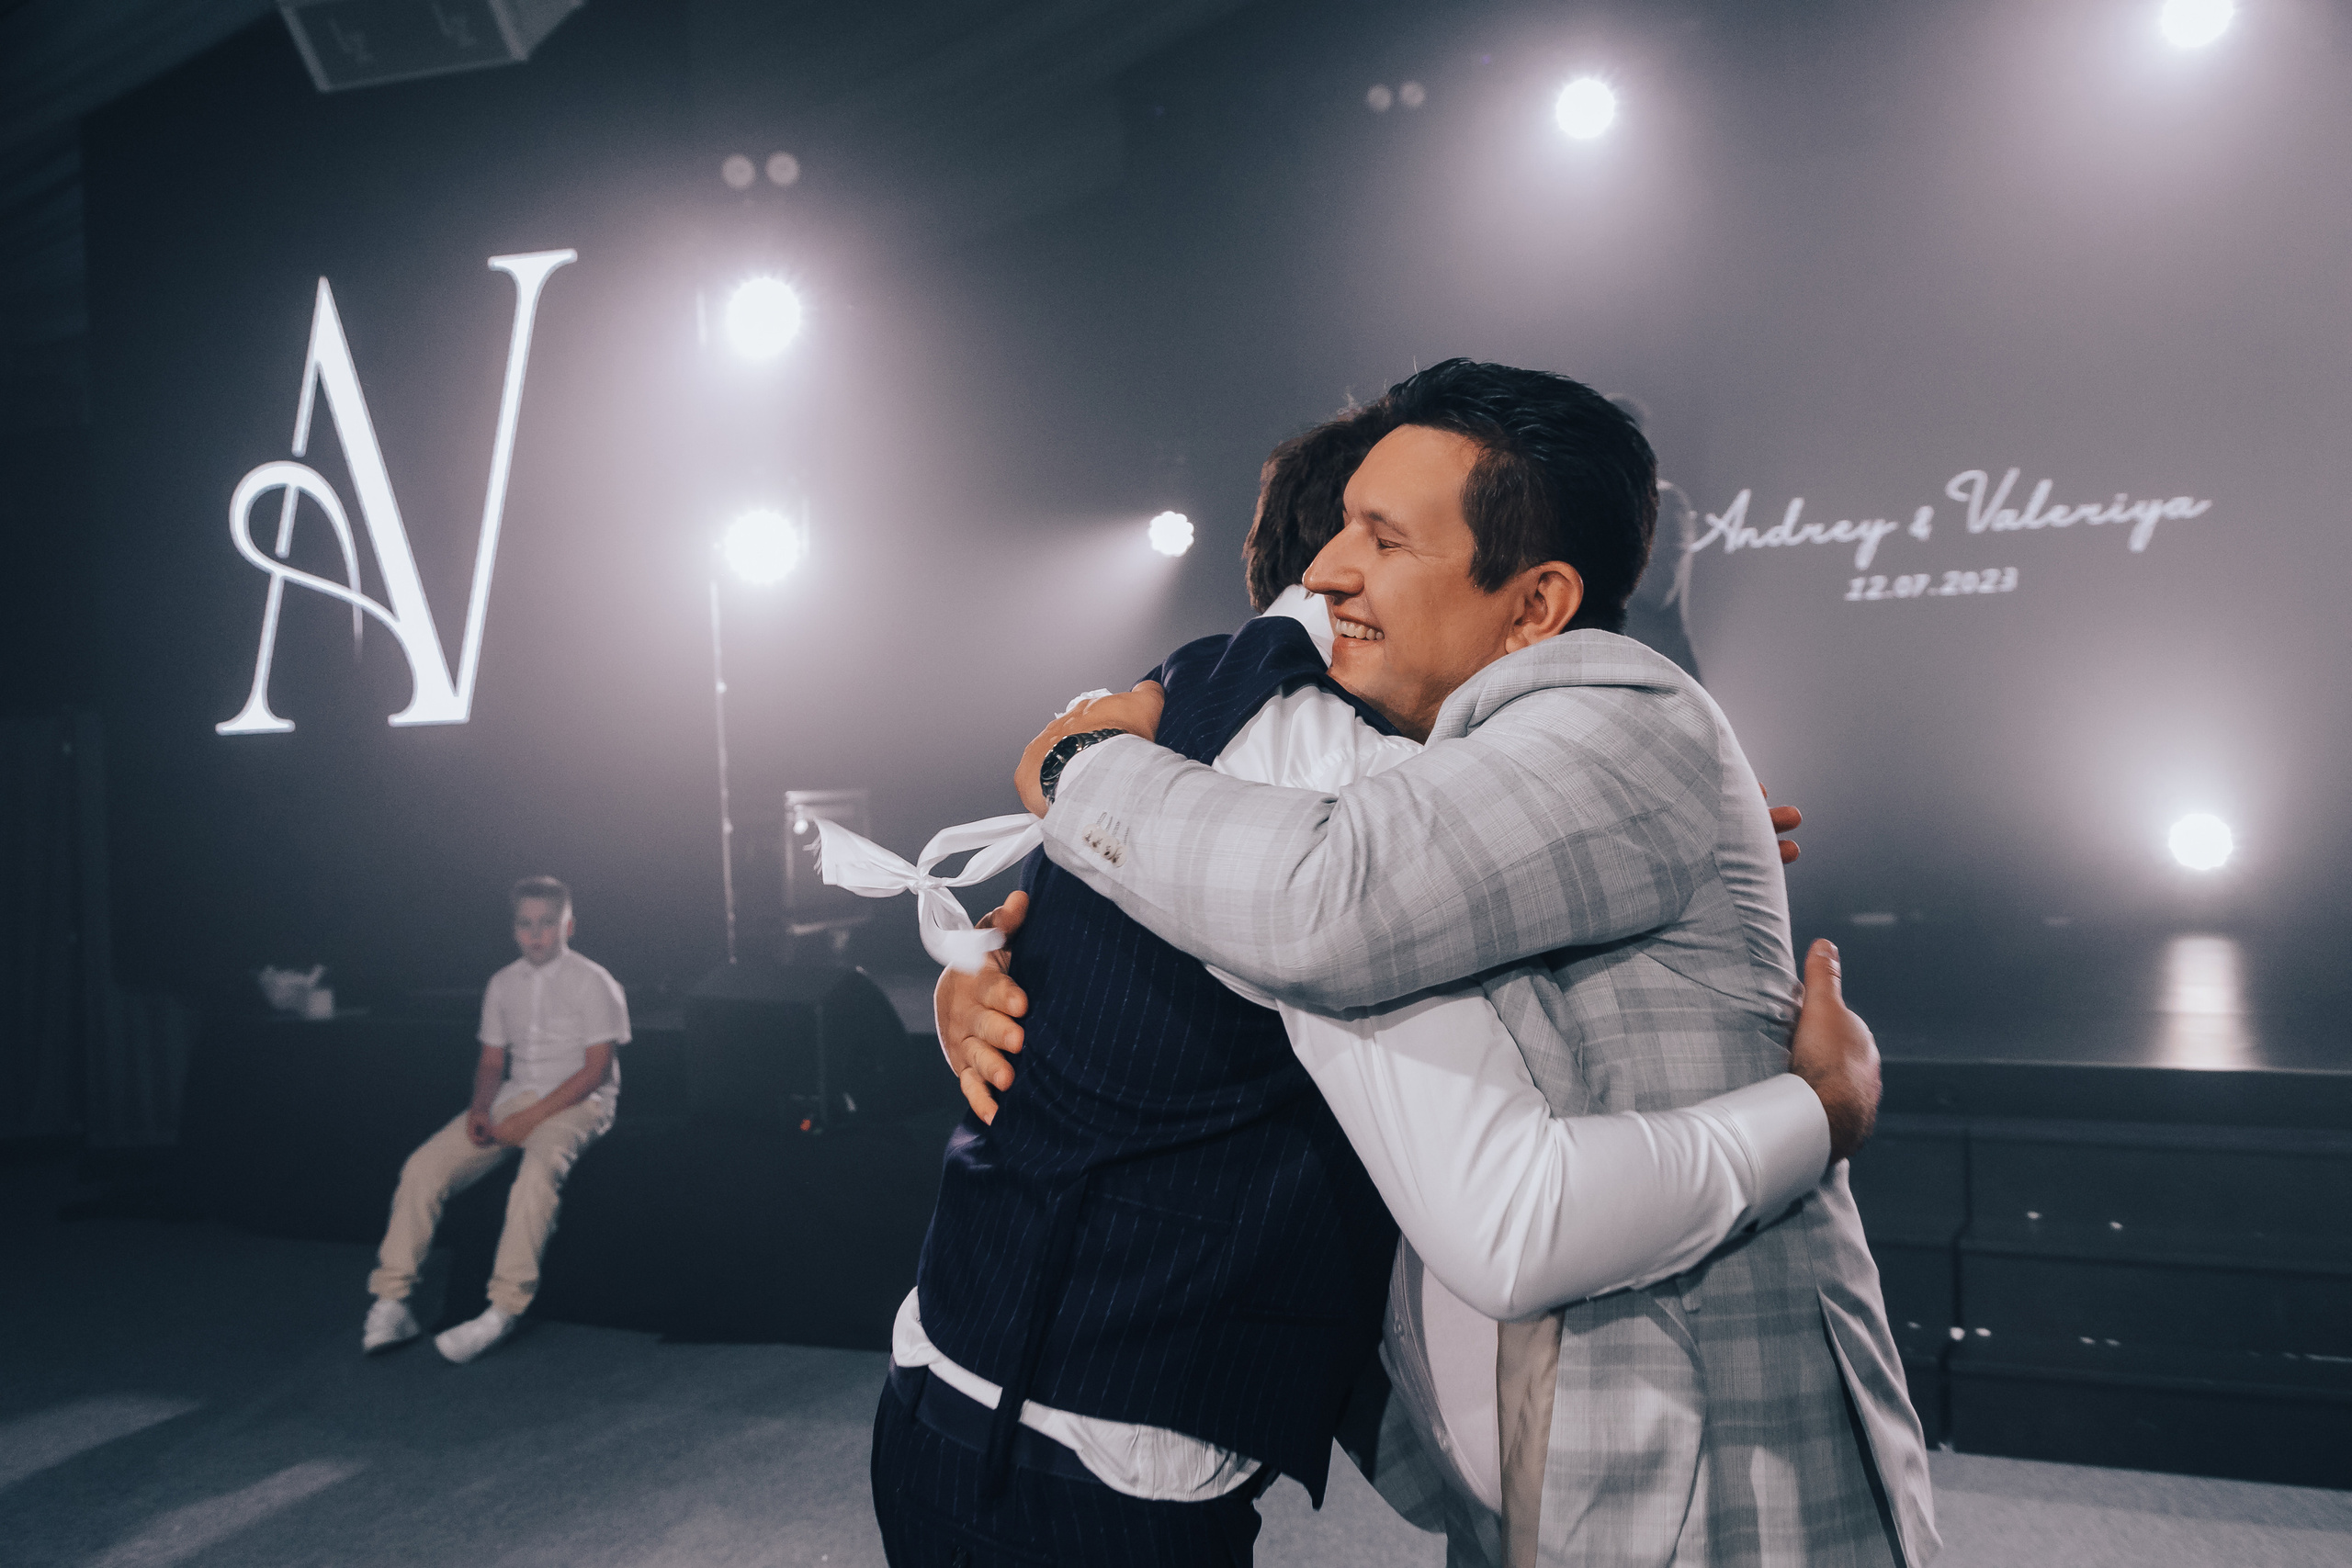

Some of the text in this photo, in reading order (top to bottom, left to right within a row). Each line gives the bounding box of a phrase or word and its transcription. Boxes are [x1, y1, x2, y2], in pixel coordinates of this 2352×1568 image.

[1690, 467, 2212, 570] Andrey & Valeriya
